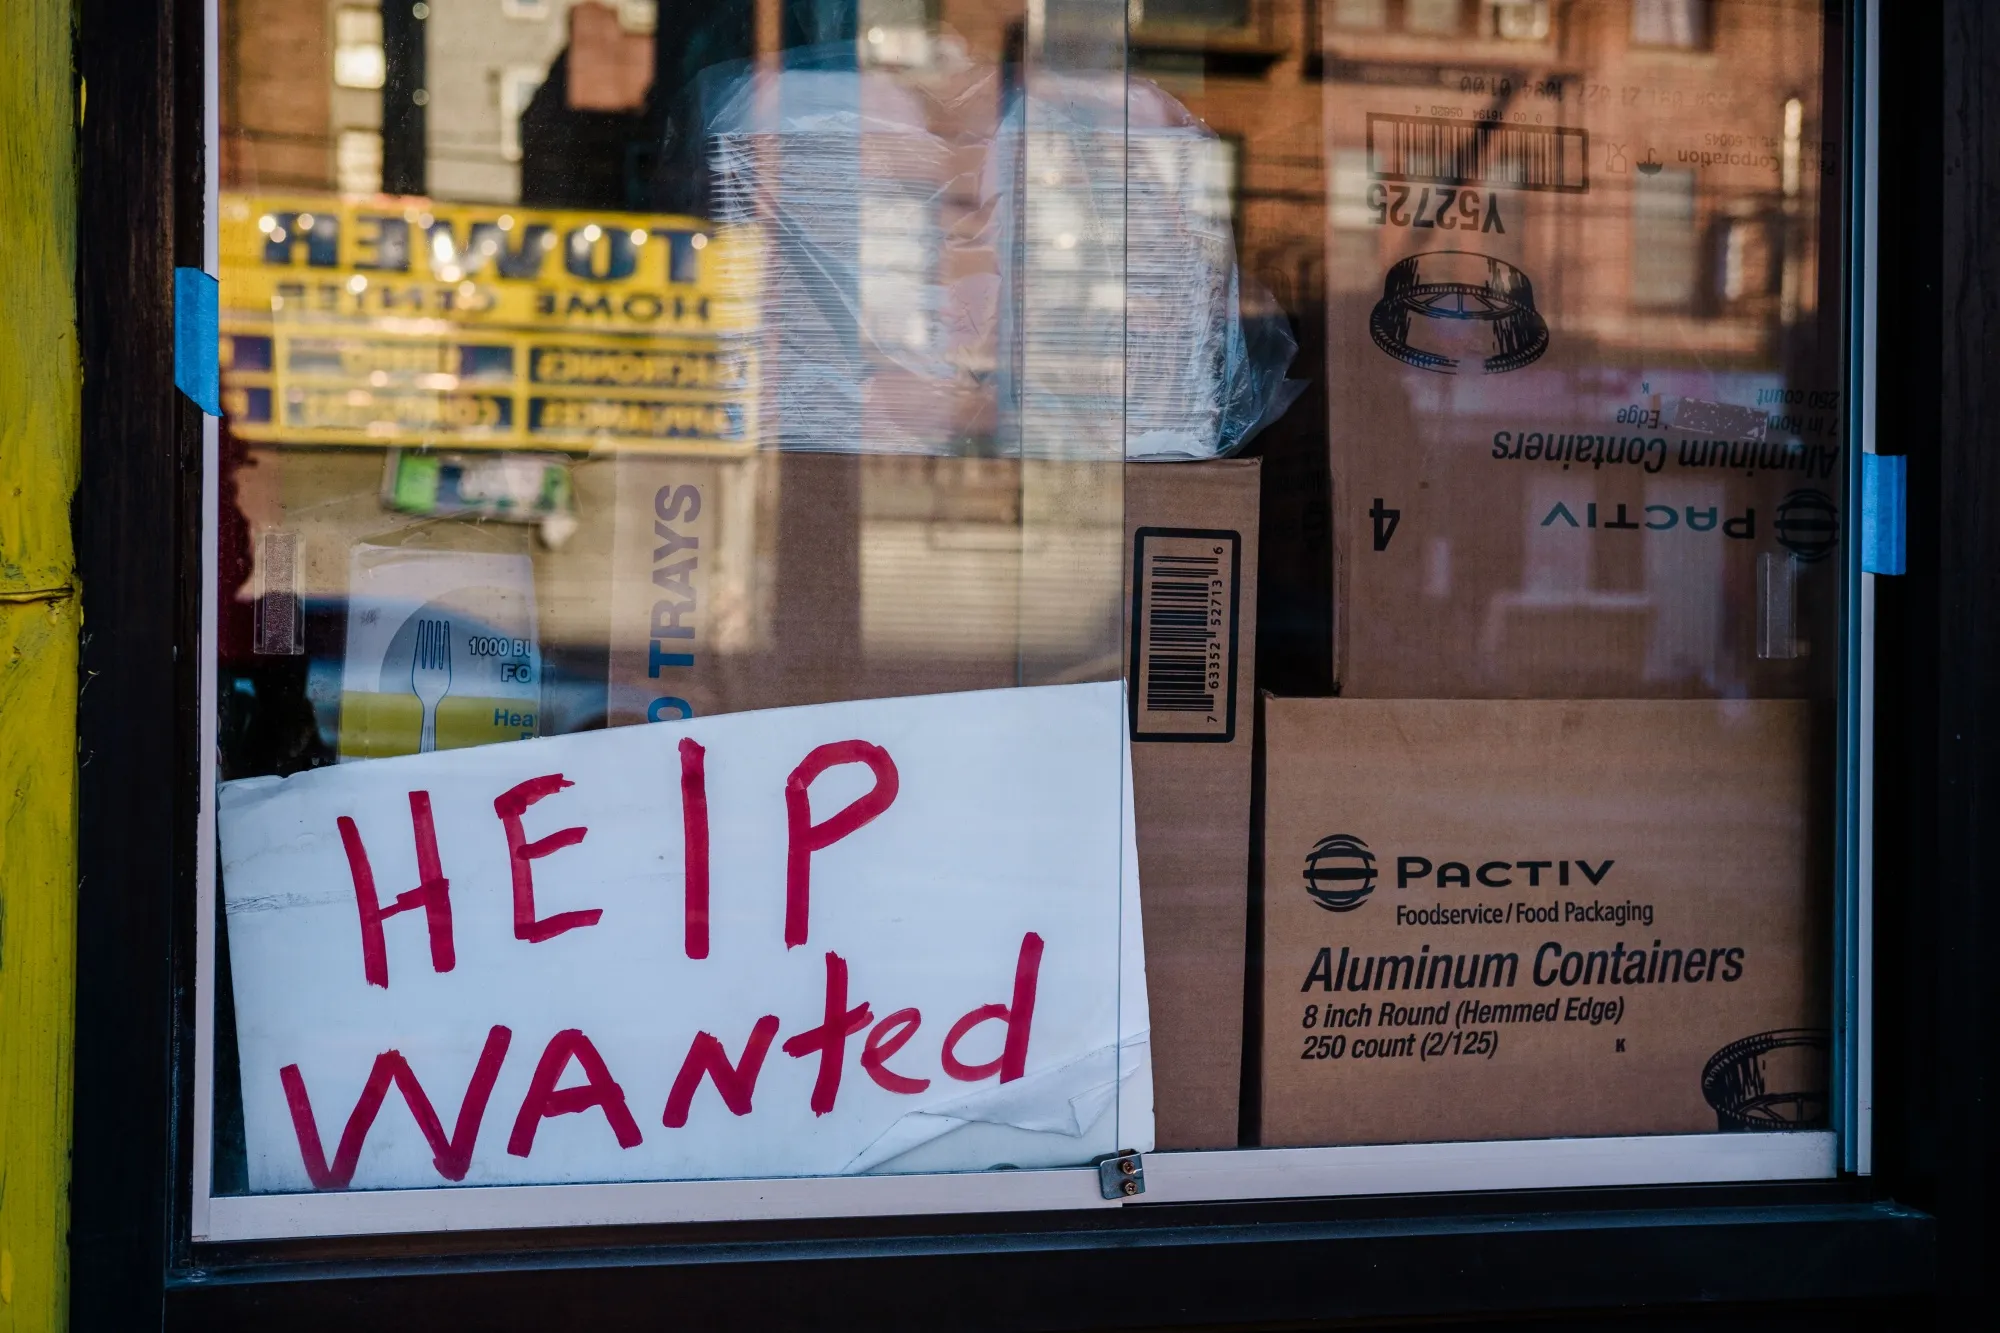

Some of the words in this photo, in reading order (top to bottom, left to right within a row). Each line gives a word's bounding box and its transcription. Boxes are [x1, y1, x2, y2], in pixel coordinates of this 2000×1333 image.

[1677, 150, 1781, 173] Corporation
[1366, 182, 1505, 234] Y52725
[1756, 387, 1803, 407] count
[1808, 389, 1841, 410] 250
[1617, 404, 1660, 429] Edge
[1492, 430, 1667, 474] Containers
[1678, 439, 1841, 480] Aluminum
[1368, 497, 1401, 552] 4
[1540, 501, 1755, 540] PACTIV
[1213, 546, 1224, 555] 6
[647, 483, 702, 679] TRAYS
[1211, 579, 1223, 627] 52713
[469, 636, 509, 657] 1000
[1208, 642, 1221, 690] 63352
[1207, 715, 1218, 724] 7
[1396, 856, 1616, 889] PACTIV
[1564, 900, 1654, 927] Packaging
[1300, 944, 1520, 993] Aluminum
[1532, 940, 1744, 988] Containers
[1302, 1004, 1318, 1029] 8
[1323, 1002, 1373, 1028] inch
[1377, 1000, 1451, 1028] Round
[1455, 997, 1561, 1030] (Hemmed
[1563, 996, 1626, 1027] Edge)
[1300, 1034, 1346, 1061] 250
[1350, 1033, 1415, 1059] count
[1420, 1030, 1500, 1062] (2/125)
[1615, 1037, 1626, 1053] K
